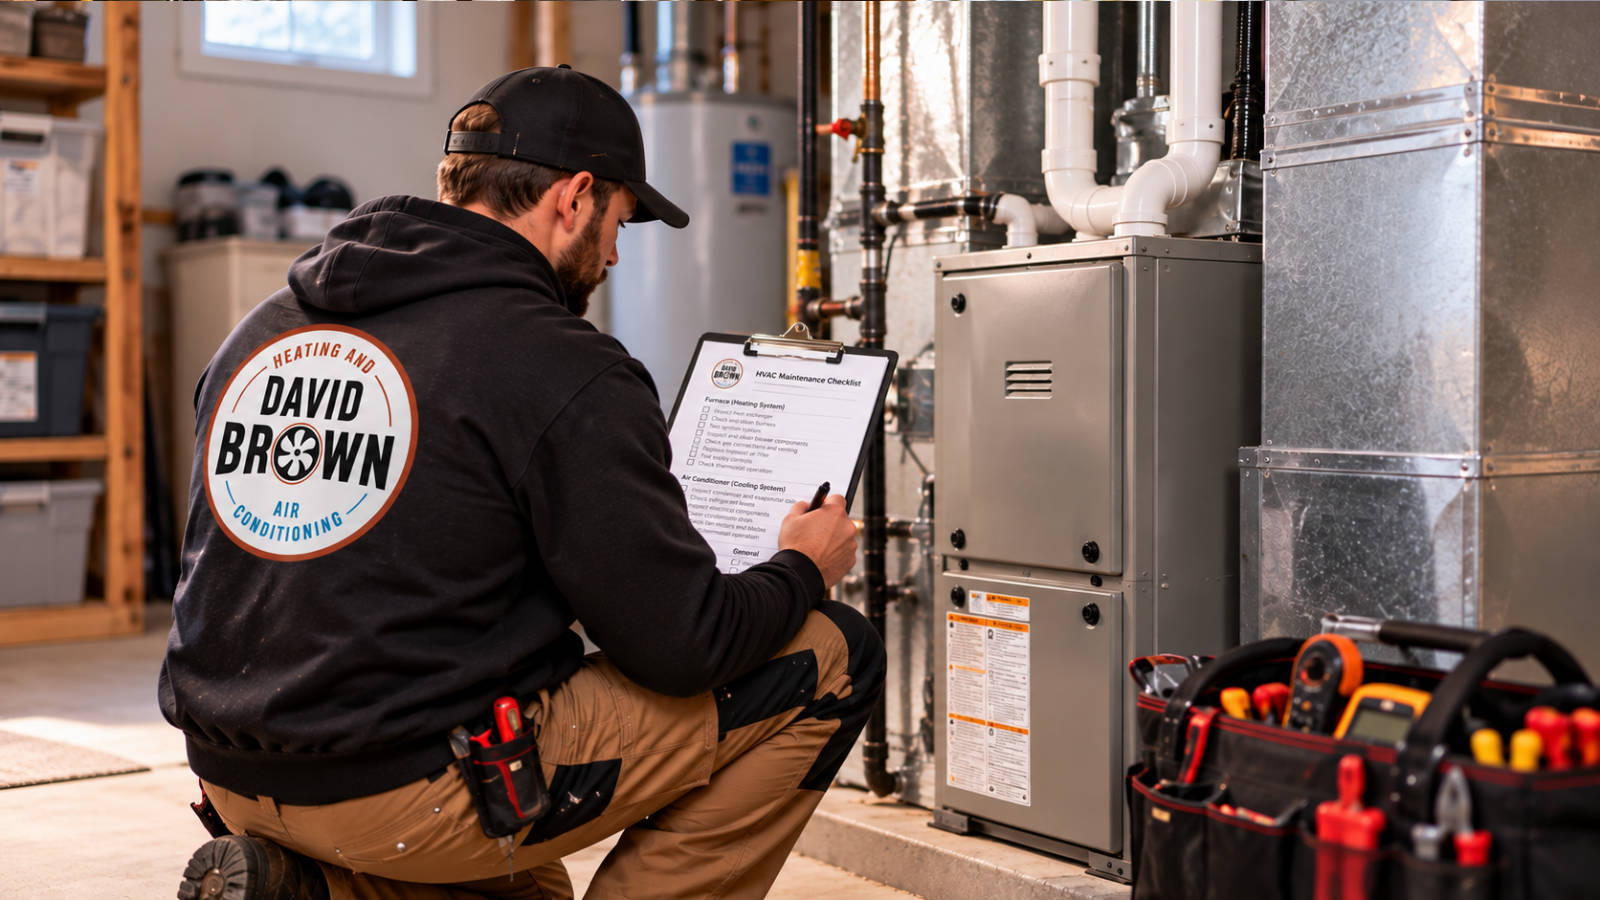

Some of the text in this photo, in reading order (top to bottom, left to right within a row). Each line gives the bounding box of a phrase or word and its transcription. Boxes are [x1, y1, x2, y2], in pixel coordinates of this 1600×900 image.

[273, 342, 376, 375] HEATING AND
[756, 370, 862, 388] HVAC Maintenance Checklist
[260, 375, 364, 422] DAVID
[704, 396, 785, 411] Furnace (Heating System)
[215, 421, 396, 491] BROWN
[691, 476, 730, 486] Conditioner
[730, 480, 759, 490] (Cooling
[759, 483, 787, 493] System)
[273, 501, 300, 519] AIR
[233, 504, 343, 543] CONDITIONING
[732, 548, 760, 558] General
